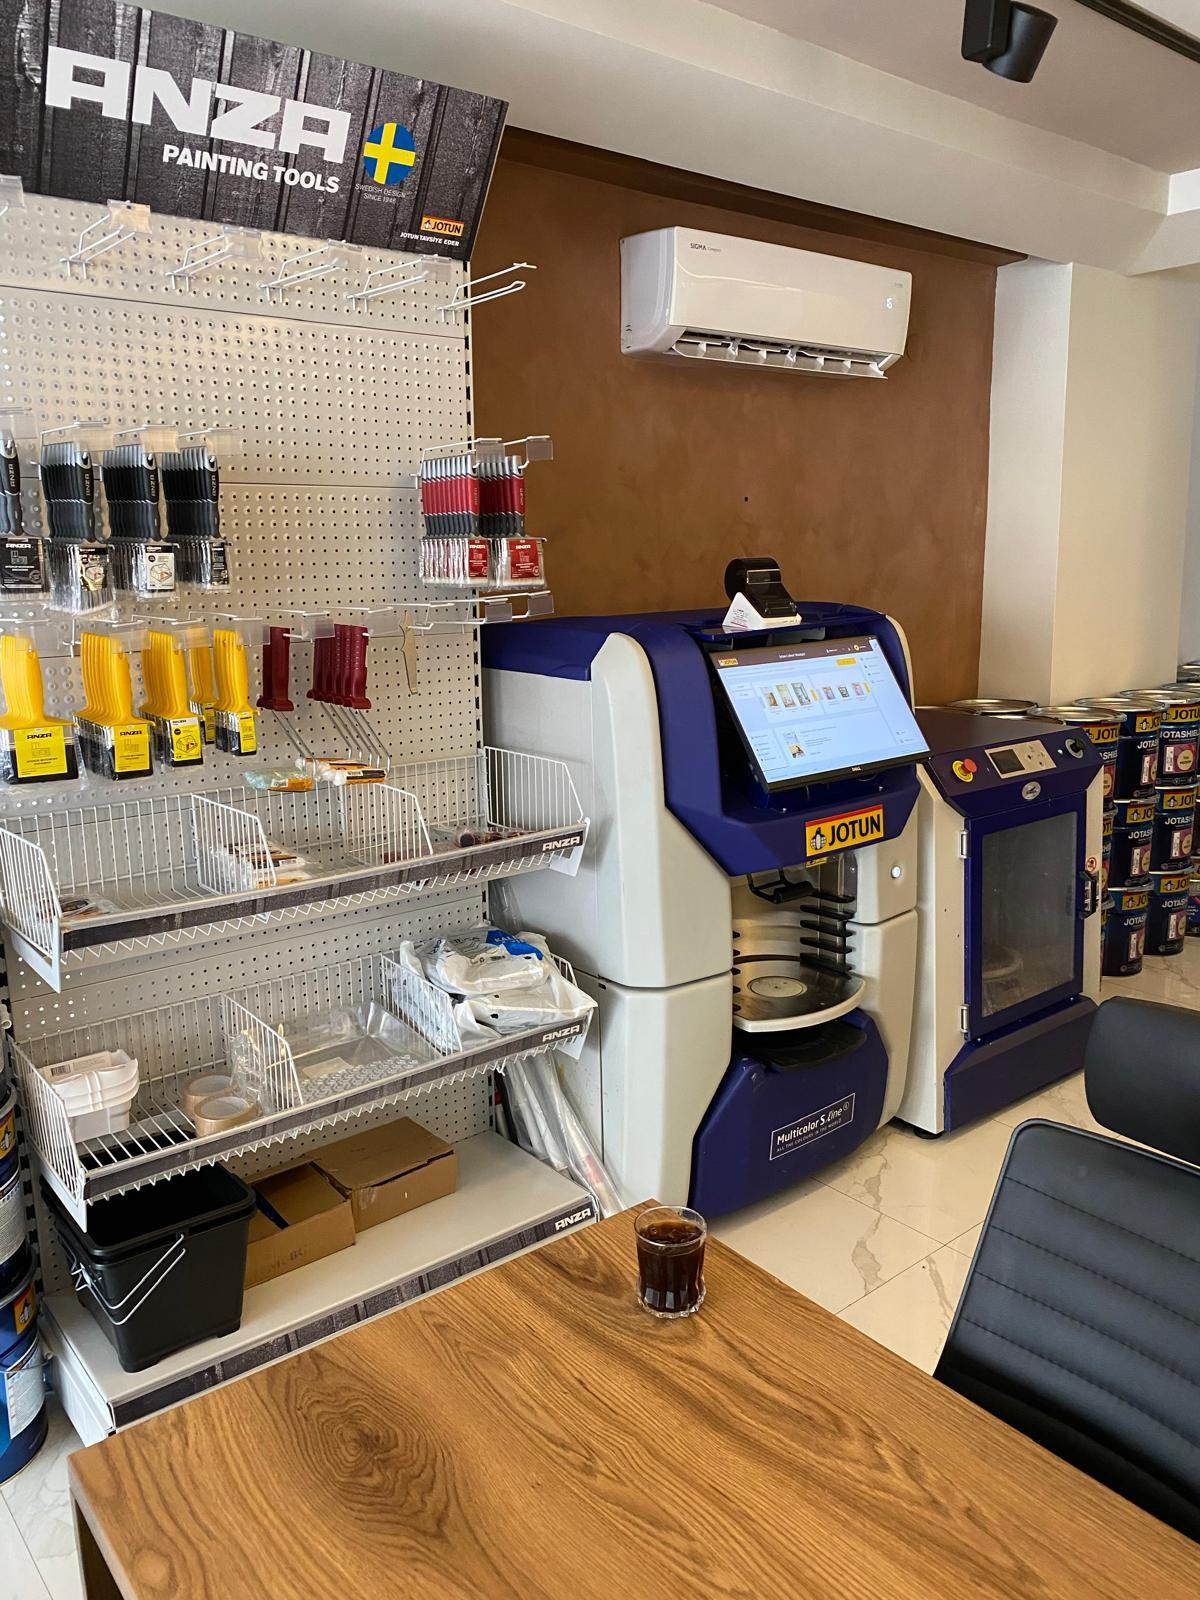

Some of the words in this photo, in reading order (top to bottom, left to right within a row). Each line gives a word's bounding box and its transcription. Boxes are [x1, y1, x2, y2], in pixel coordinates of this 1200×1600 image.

[45, 46, 351, 164] ANZA
[163, 144, 268, 181] PAINTING
[273, 166, 340, 194] TOOLS
[355, 183, 383, 194] SWEDISH
[383, 188, 406, 198] DESIGN
[363, 193, 382, 202] SINCE
[432, 219, 462, 234] JOTUN
[400, 231, 420, 241] JOTUN
[443, 239, 460, 247] EDER
[8, 463, 16, 488] ANZA
[27, 732, 52, 740] ANZA
[828, 814, 881, 847] JOTUN
[542, 836, 581, 852] ANZA
[542, 1024, 580, 1043] ANZA
[776, 1119, 820, 1146] Multicolor
[554, 1207, 592, 1231] ANZA
